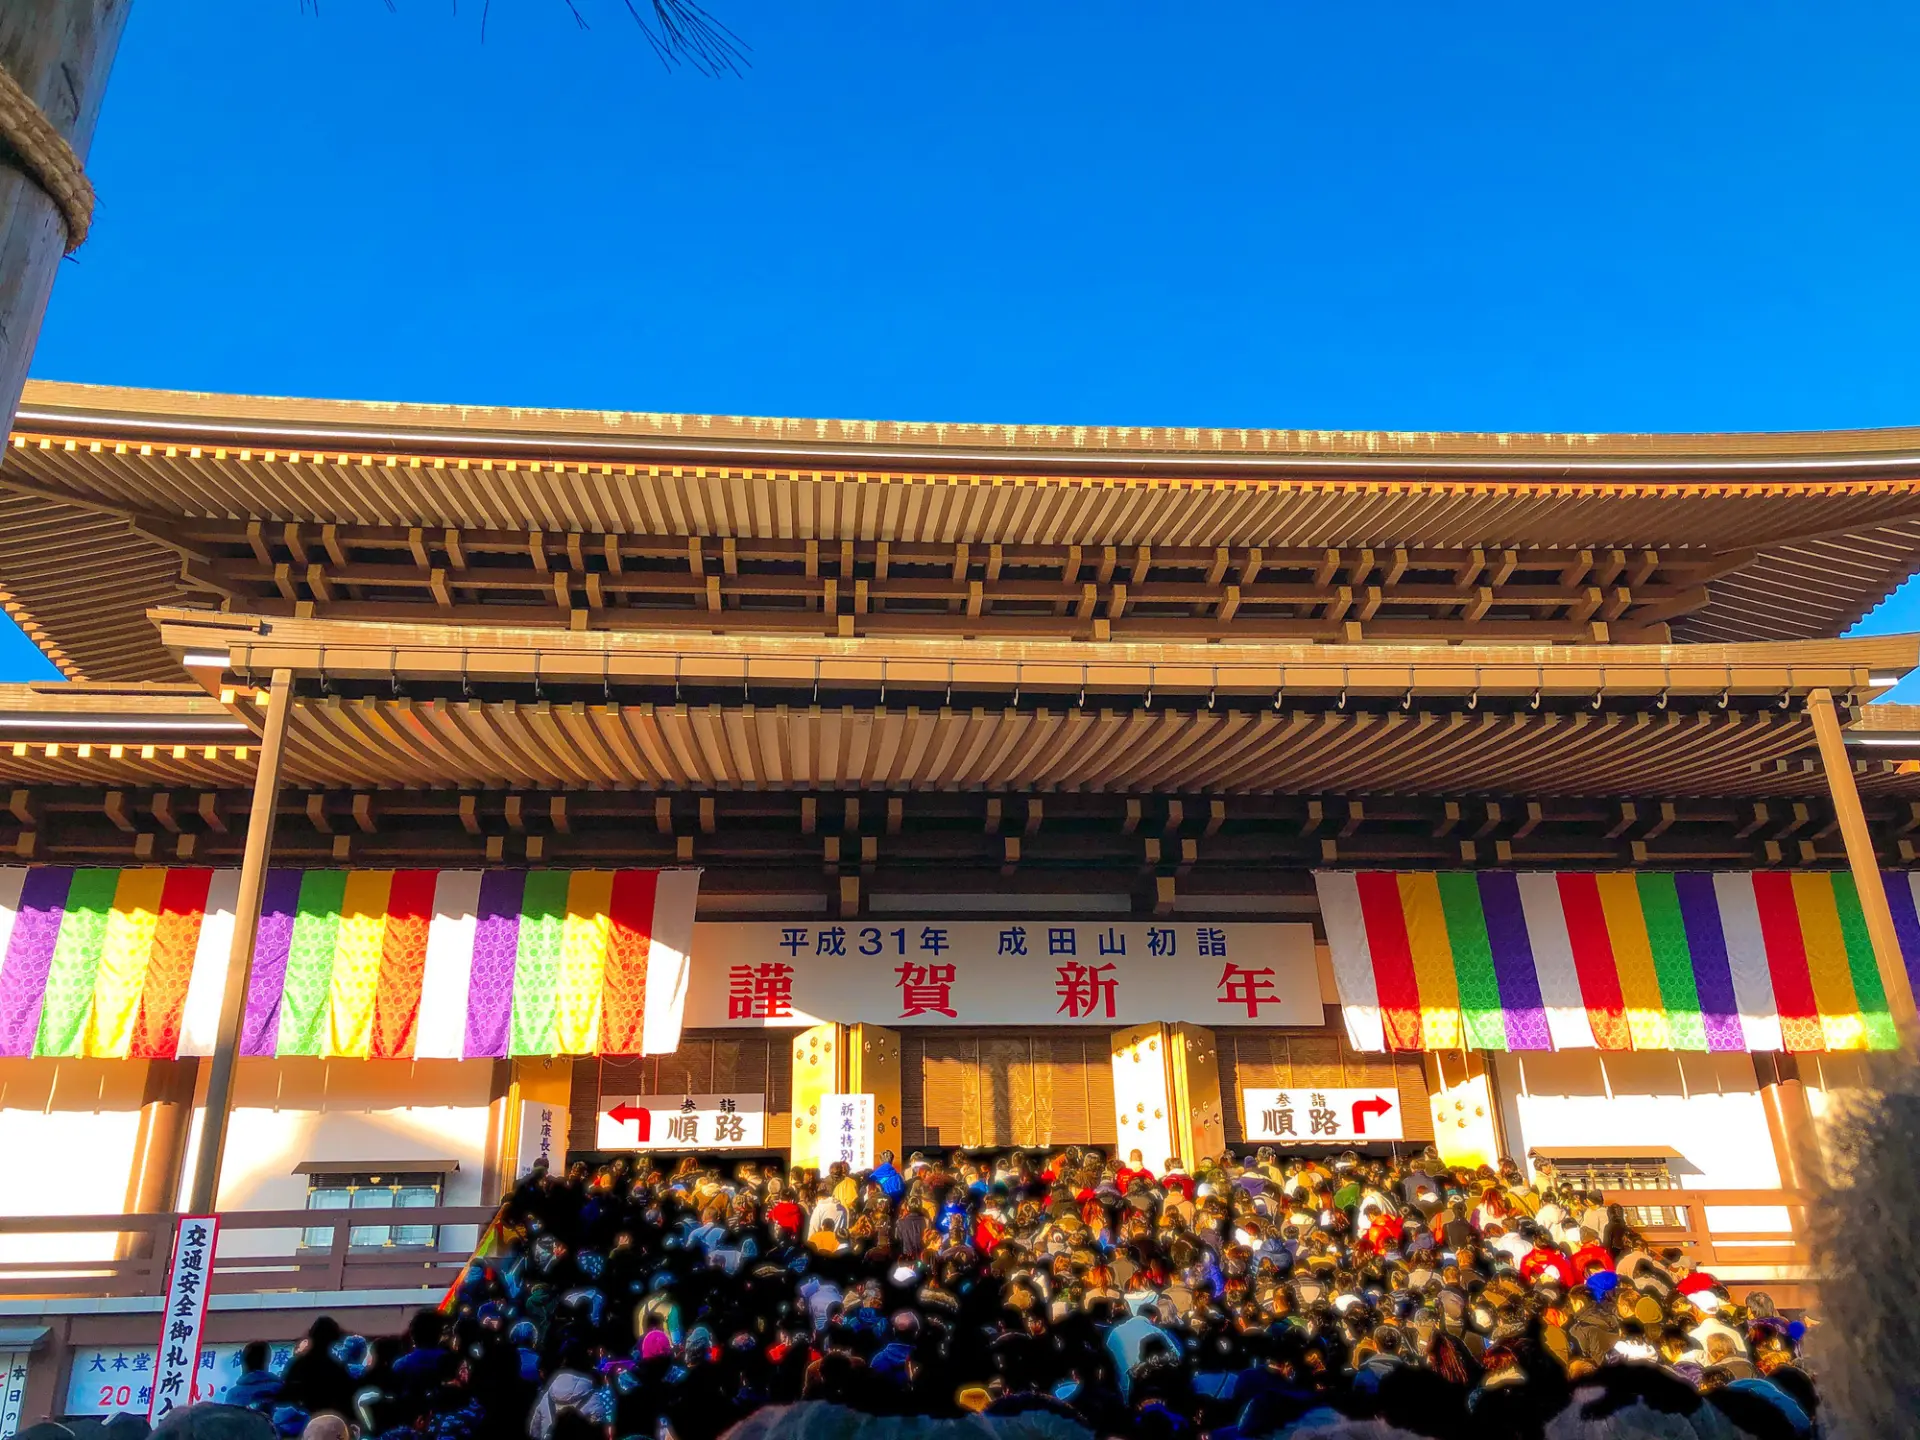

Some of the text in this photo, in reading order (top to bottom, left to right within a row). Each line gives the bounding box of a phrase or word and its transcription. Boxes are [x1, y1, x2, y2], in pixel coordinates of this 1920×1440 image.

[779, 926, 1228, 957] 平成31年 成田山初詣
[728, 960, 1282, 1020] 謹賀新年
[667, 1114, 748, 1144] 順路
[1261, 1107, 1342, 1137] 順路
[156, 1224, 208, 1422] 交通安全御札所入
